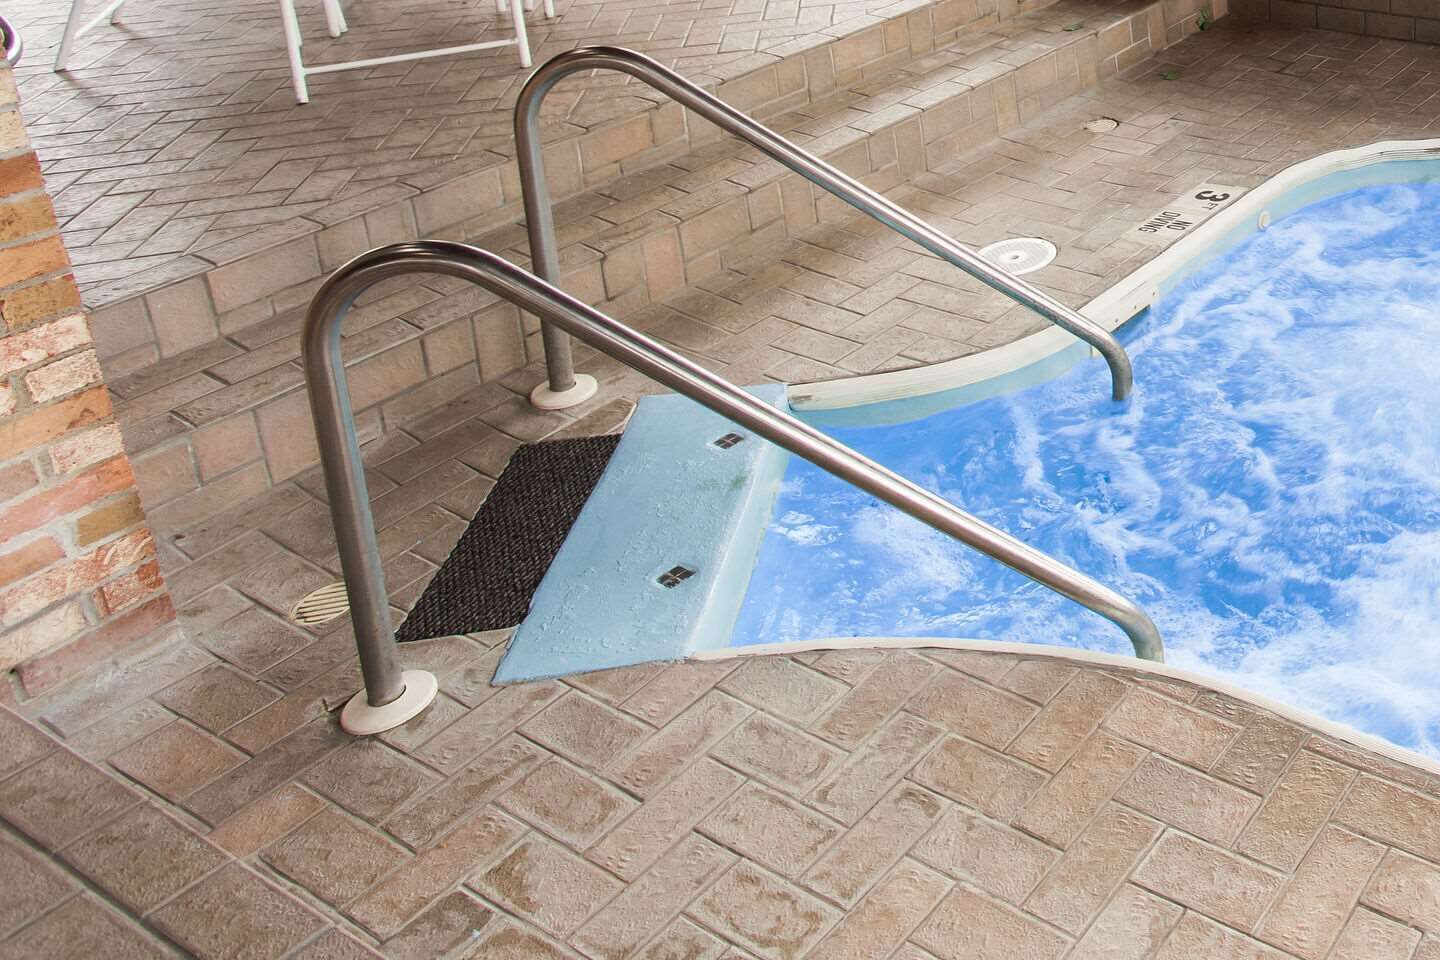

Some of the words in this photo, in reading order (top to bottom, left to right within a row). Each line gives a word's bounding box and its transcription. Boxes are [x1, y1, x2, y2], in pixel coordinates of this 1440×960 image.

[1195, 191, 1230, 201] 3
[1202, 202, 1218, 210] FT
[1138, 211, 1181, 233] DIVING
[1166, 220, 1192, 231] NO
